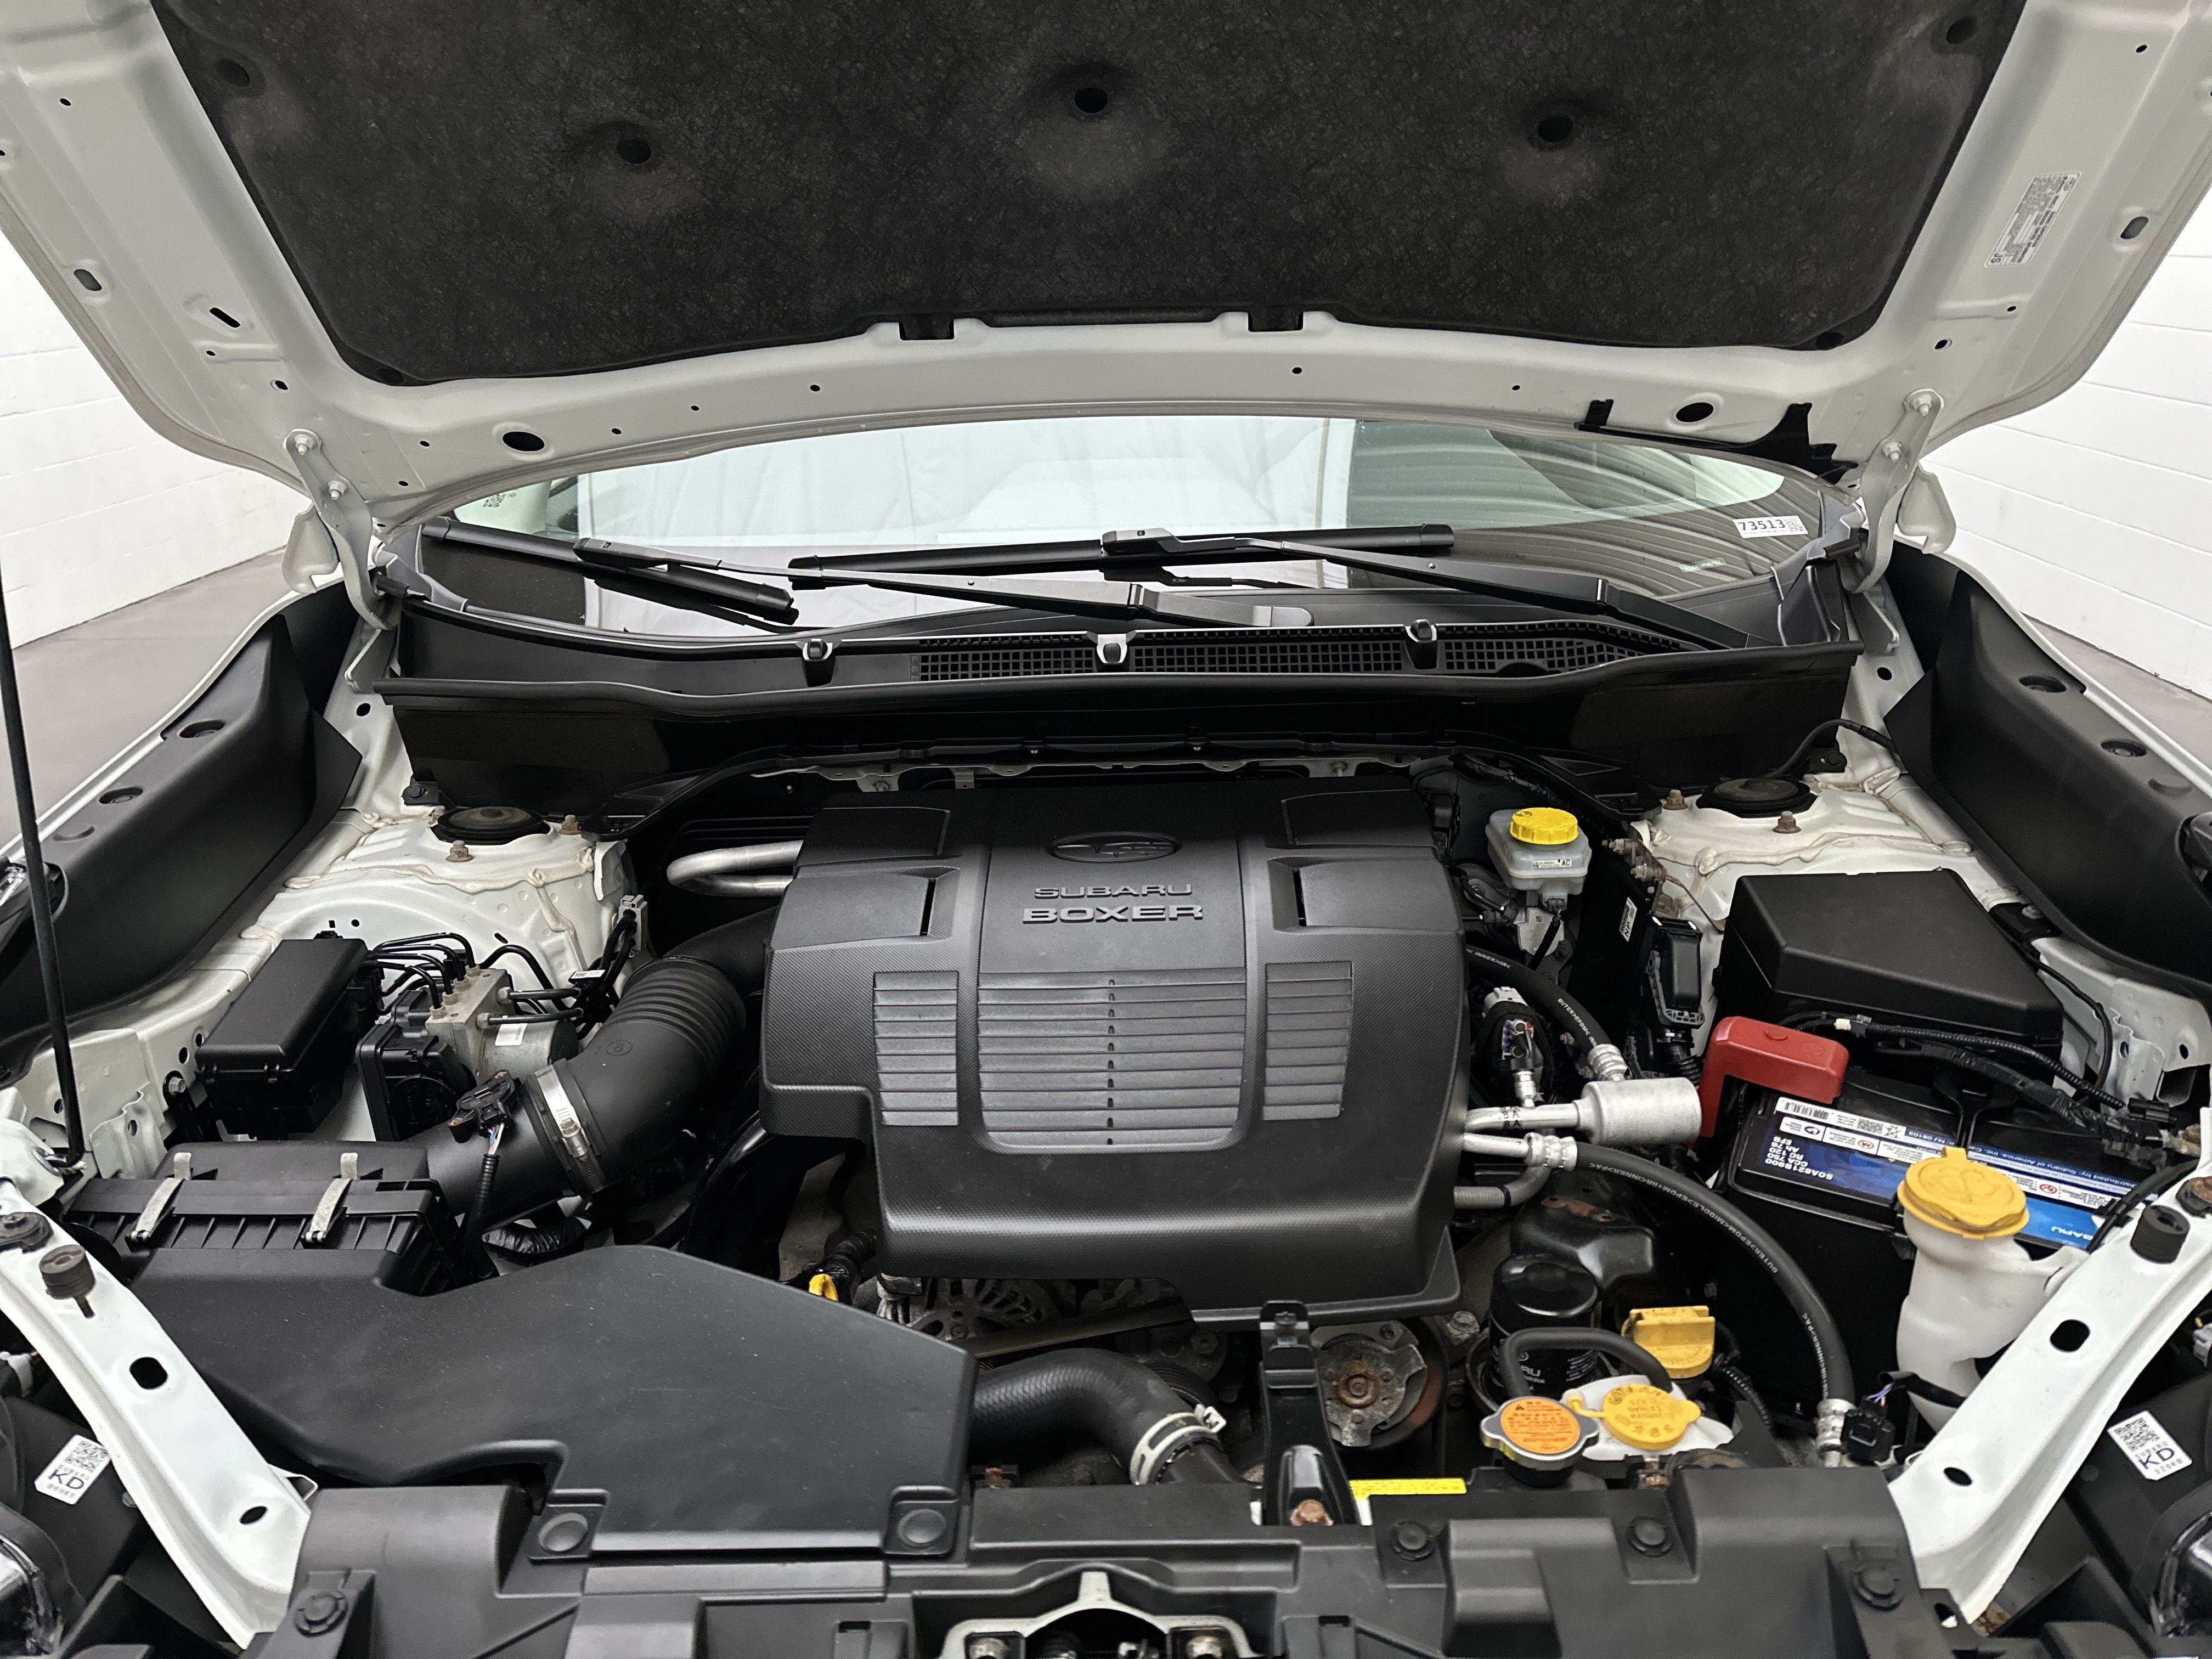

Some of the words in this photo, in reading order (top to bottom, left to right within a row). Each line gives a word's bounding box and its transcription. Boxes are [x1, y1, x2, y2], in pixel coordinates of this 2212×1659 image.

[1991, 253, 2004, 263] JS
[1737, 519, 1786, 531] 73513
[1034, 884, 1193, 899] SUBARU
[1022, 904, 1204, 924] BOXER
[1908, 1131, 1933, 1139] 08103
[1773, 1136, 1792, 1146] EFB
[1768, 1147, 1787, 1155] 120
[1785, 1145, 1799, 1153] Ah
[1767, 1152, 1786, 1161] 750
[1788, 1152, 1804, 1160] RC
[1788, 1157, 1808, 1167] CCA
[2046, 1163, 2076, 1175] Subaru
[2138, 1448, 2175, 1470] KD
[48, 1469, 84, 1489] KD
